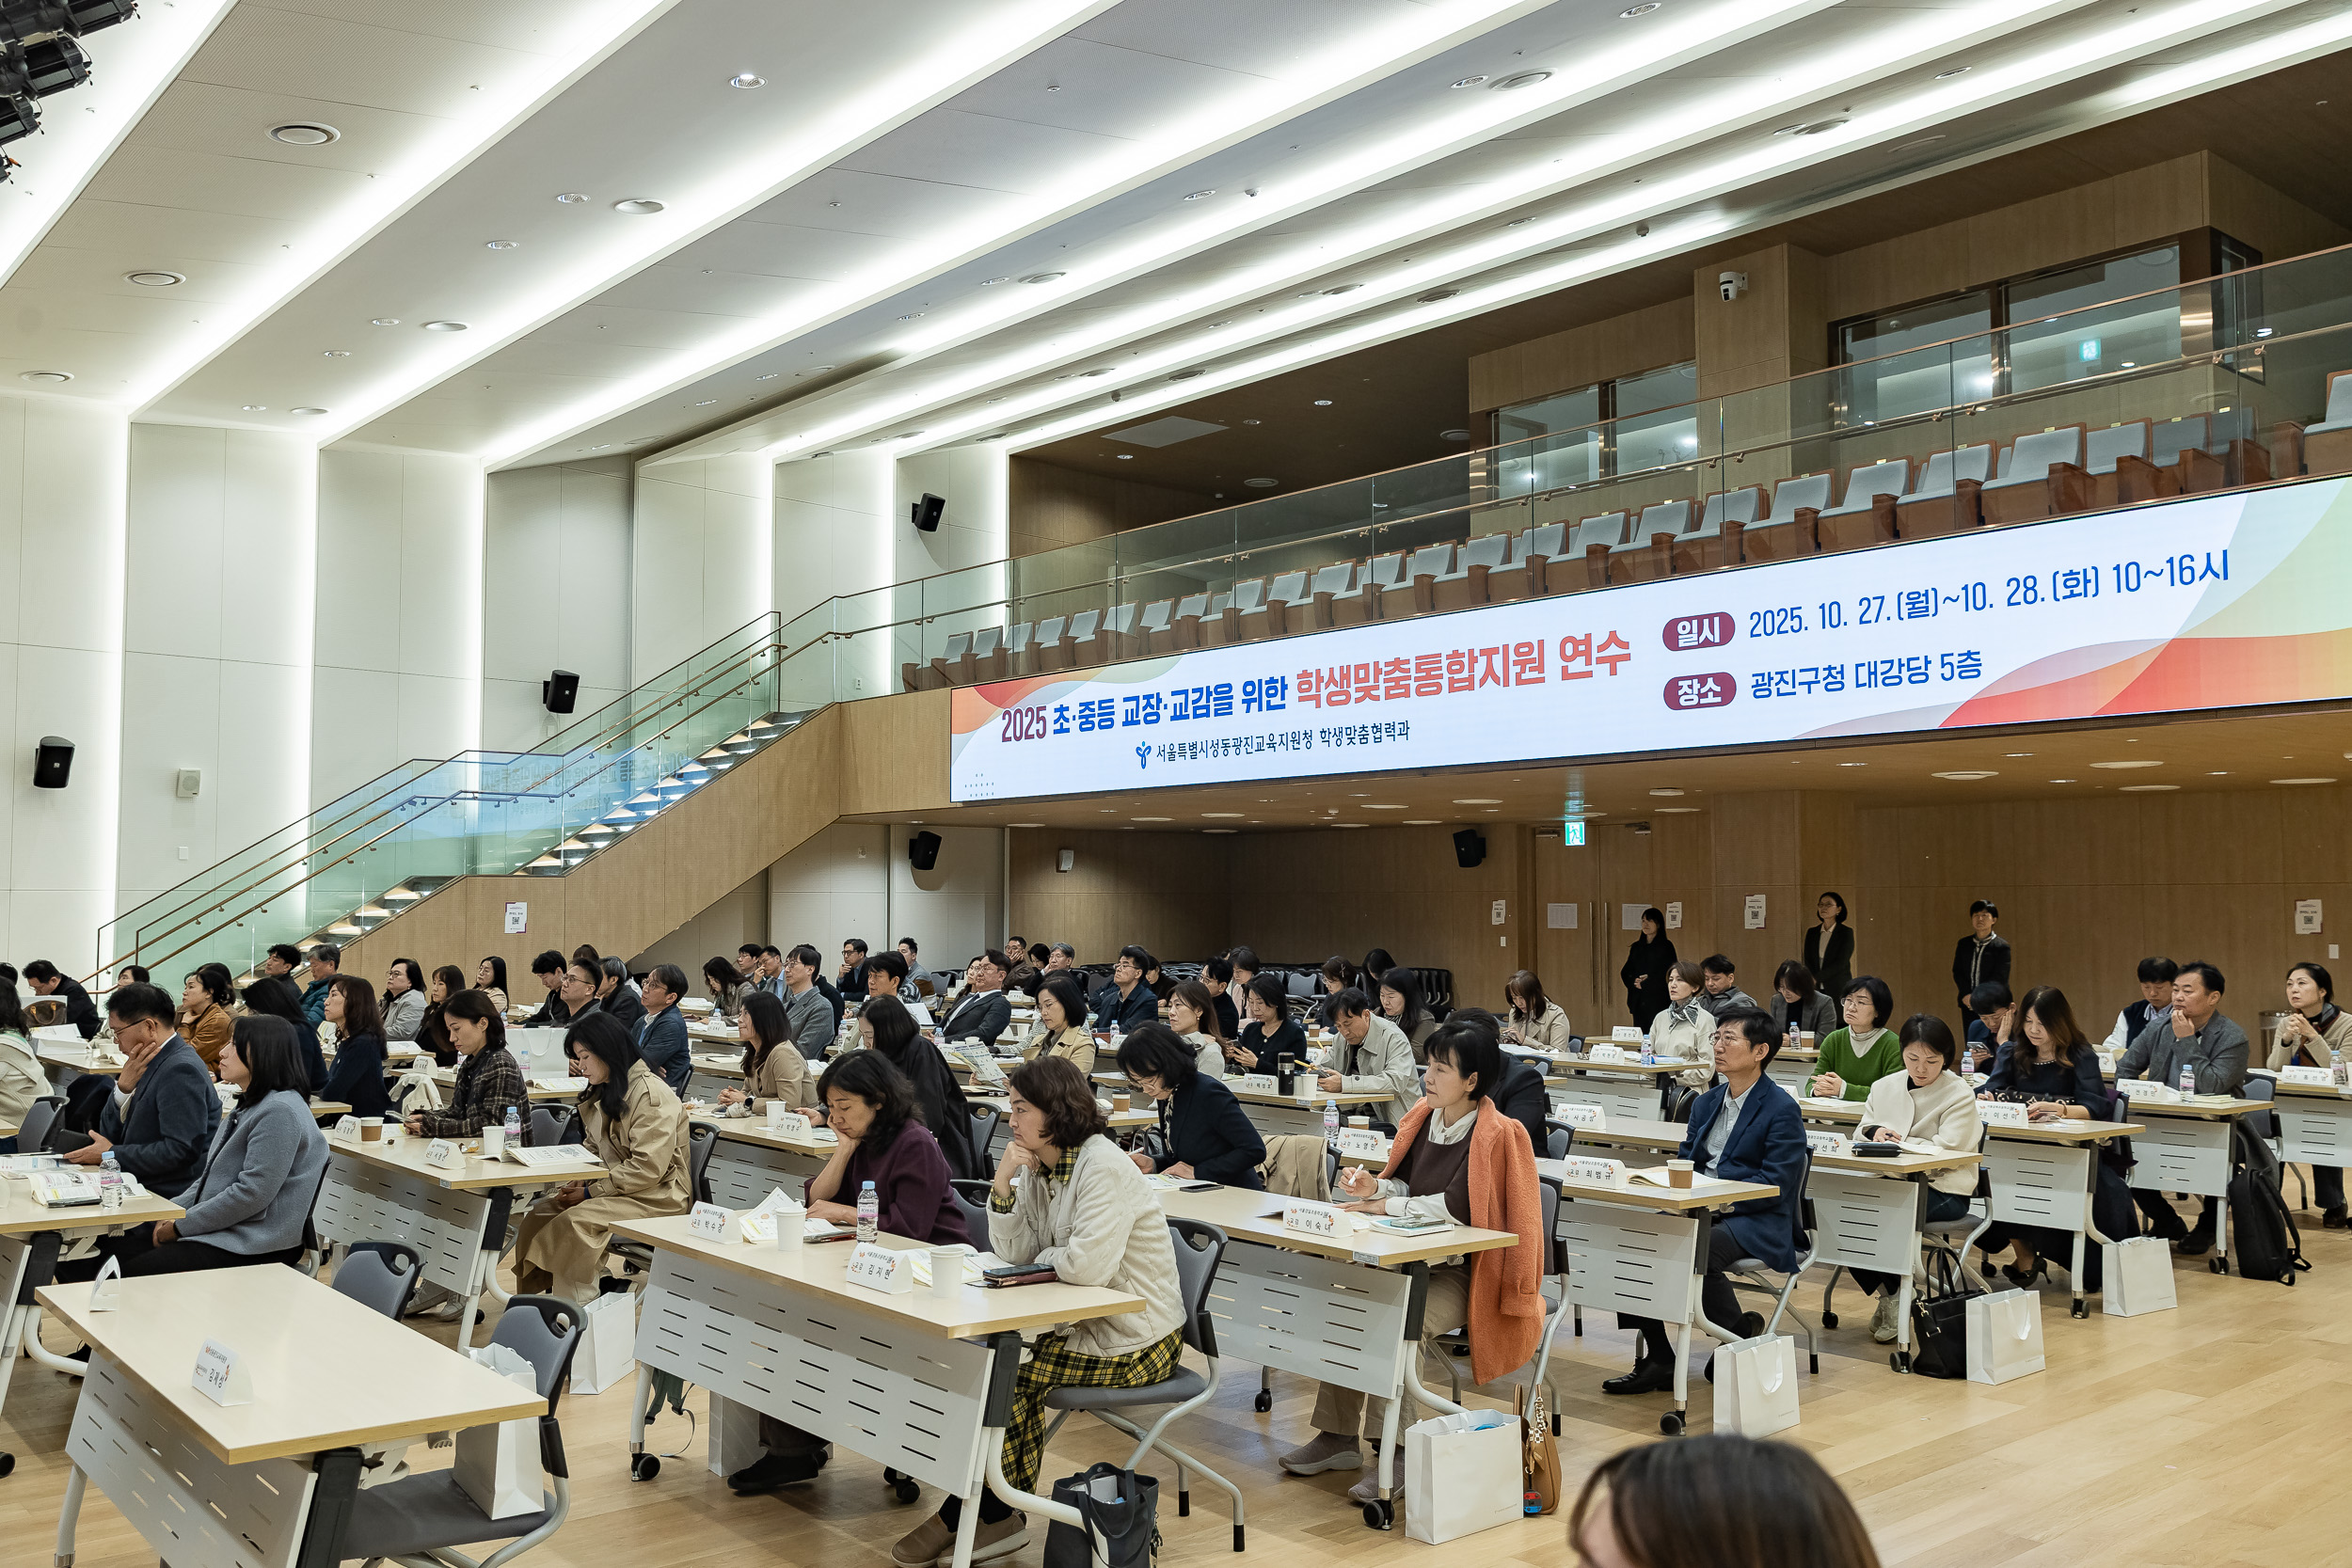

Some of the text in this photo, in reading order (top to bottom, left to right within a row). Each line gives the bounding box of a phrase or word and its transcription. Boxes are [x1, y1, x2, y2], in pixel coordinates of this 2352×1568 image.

[1749, 607, 1809, 639] 2025.
[1818, 601, 1848, 630] 10.
[2112, 549, 2229, 594] 10~16시
[1677, 616, 1720, 646] 일시
[1000, 629, 1631, 743] 2025 초·중등 교장·교감을 위한 학생맞춤통합지원 연수
[1677, 678, 1722, 706] 장소
[1751, 650, 1983, 700] 광진구청 대강당 5층
[1155, 720, 1411, 763] 서울특별시성동광진교육지원청 학생맞춤협력과
